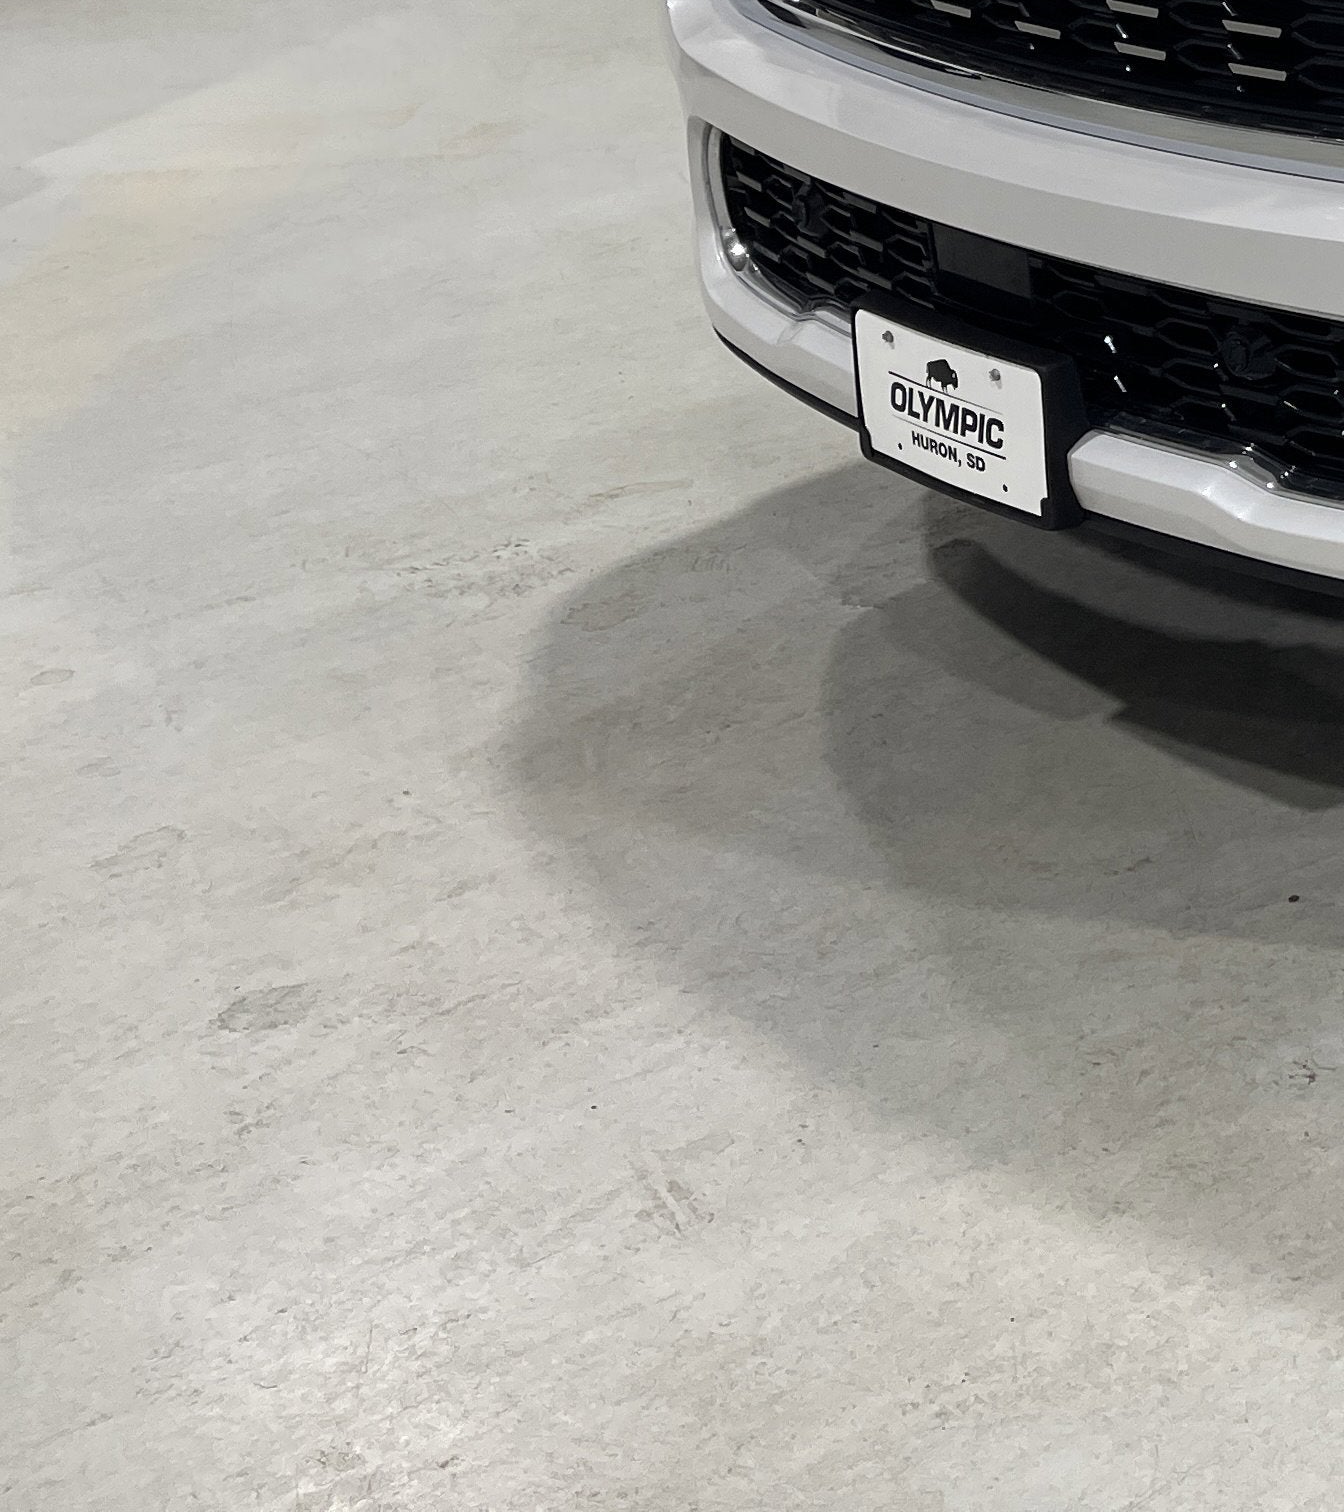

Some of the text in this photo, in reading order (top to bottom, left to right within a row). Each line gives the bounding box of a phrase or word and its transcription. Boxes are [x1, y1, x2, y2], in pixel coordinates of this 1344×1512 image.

[890, 381, 1005, 450] OLYMPIC
[911, 430, 986, 472] HURON, SD
